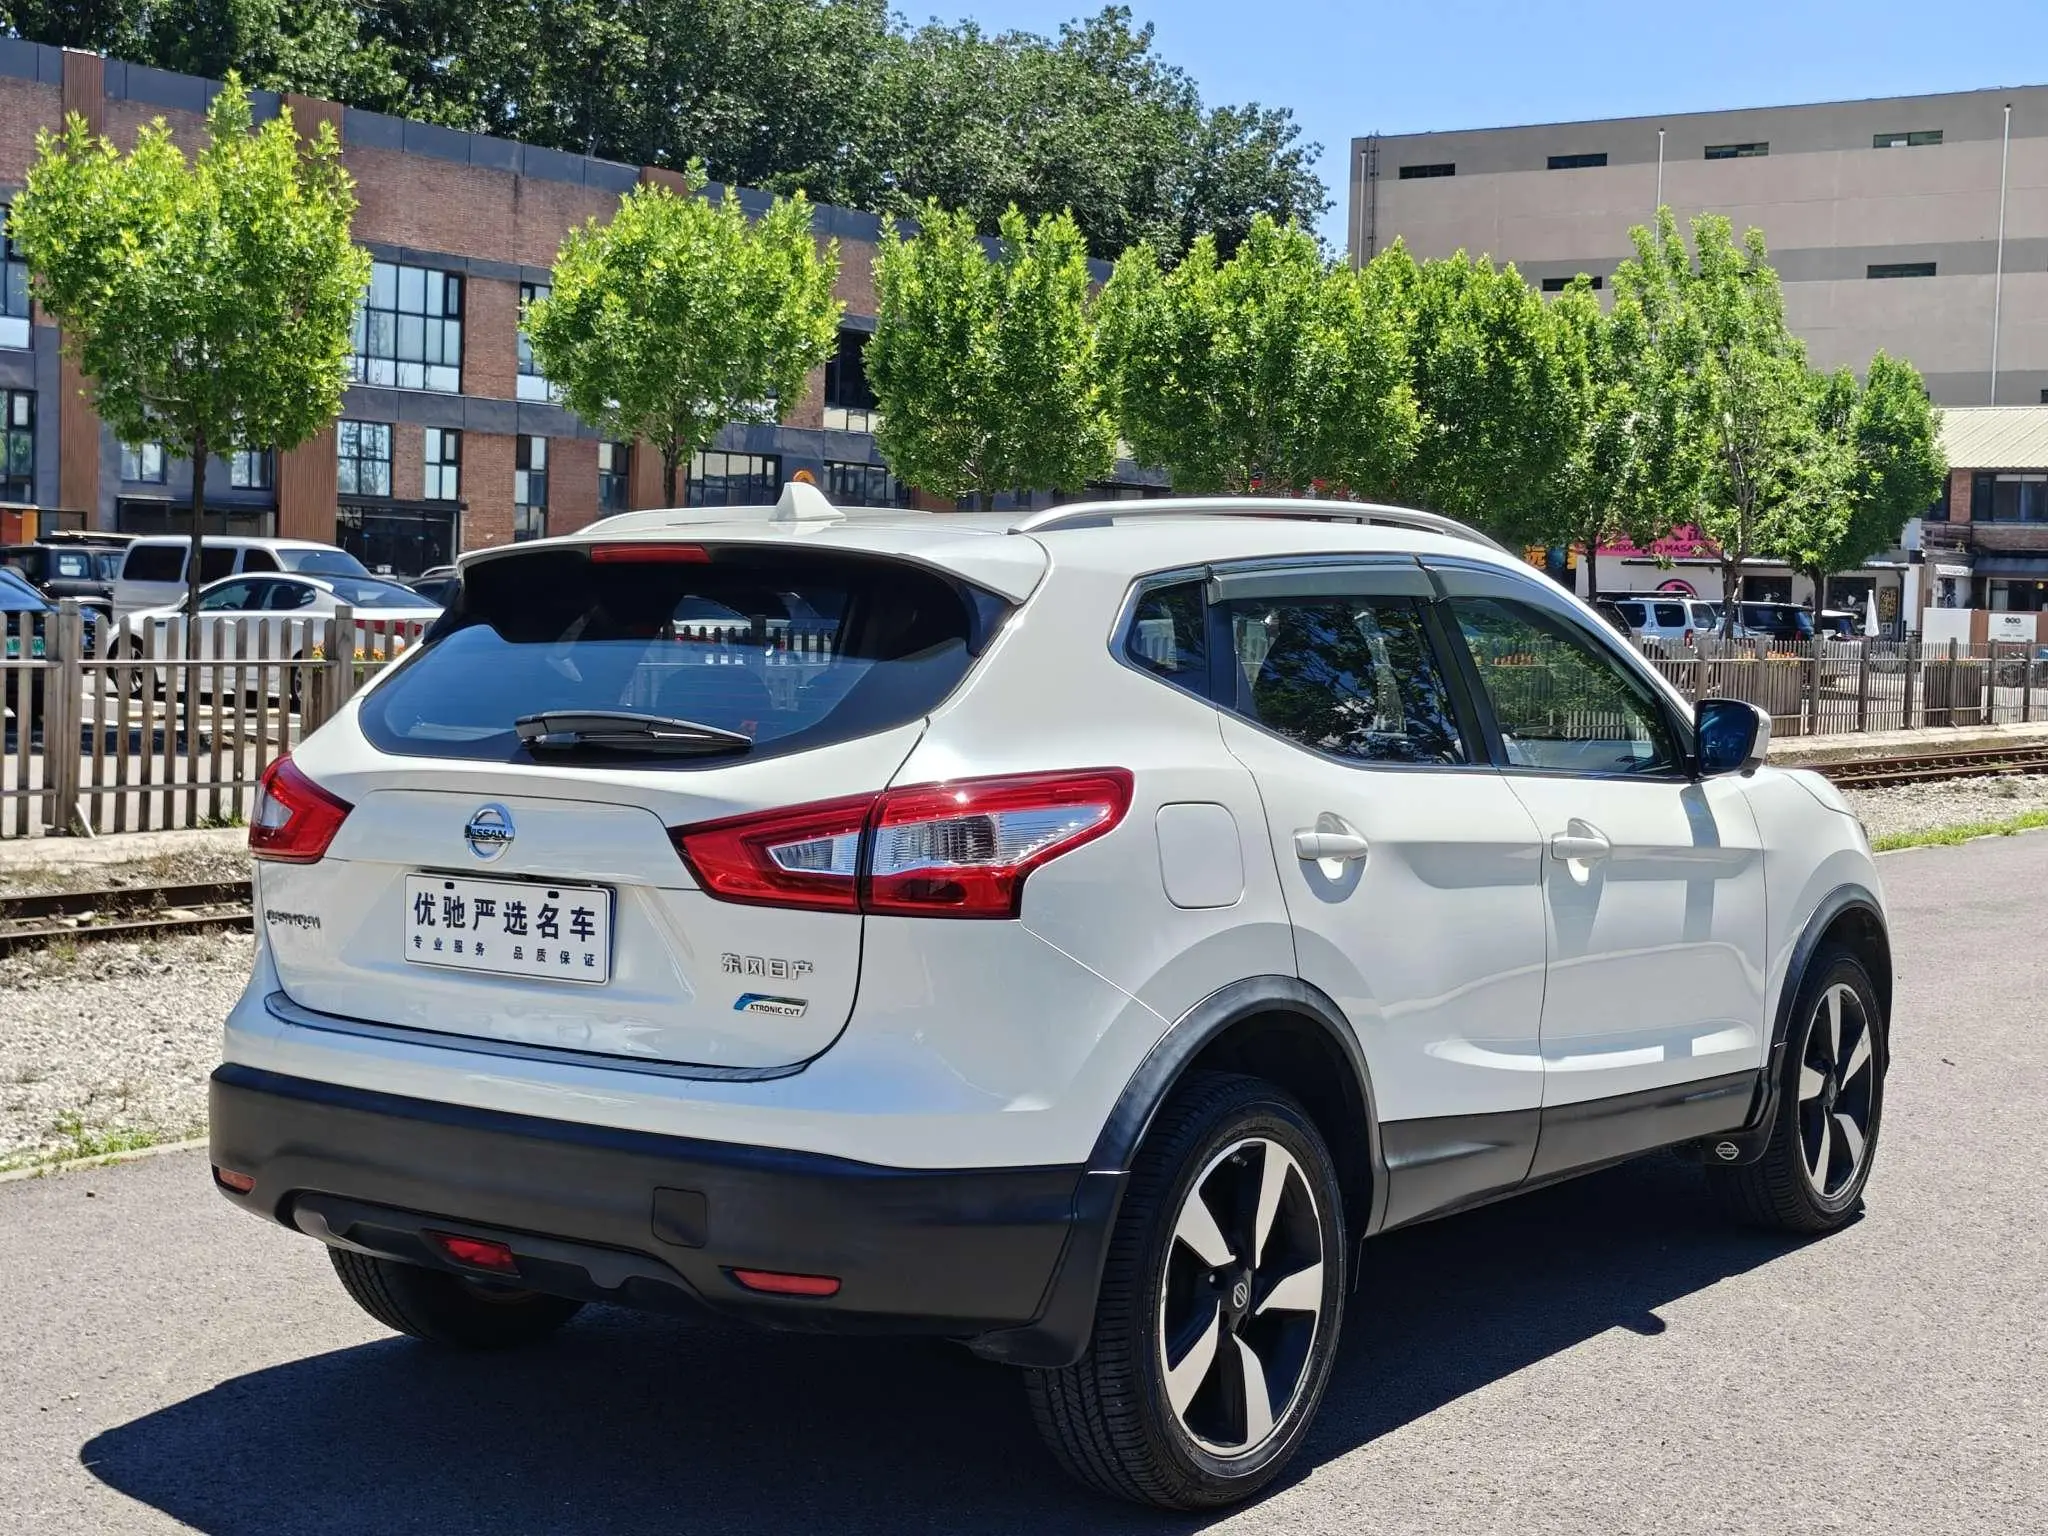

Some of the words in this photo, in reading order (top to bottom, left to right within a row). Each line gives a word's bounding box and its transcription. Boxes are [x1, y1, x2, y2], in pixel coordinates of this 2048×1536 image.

[414, 892, 595, 942] 优驰严选名车
[413, 935, 485, 957] 专业服务
[513, 946, 596, 967] 品质保证
[720, 952, 814, 980] 东风日产
[749, 1003, 783, 1014] XTRONIC
[784, 1006, 801, 1016] CVT
